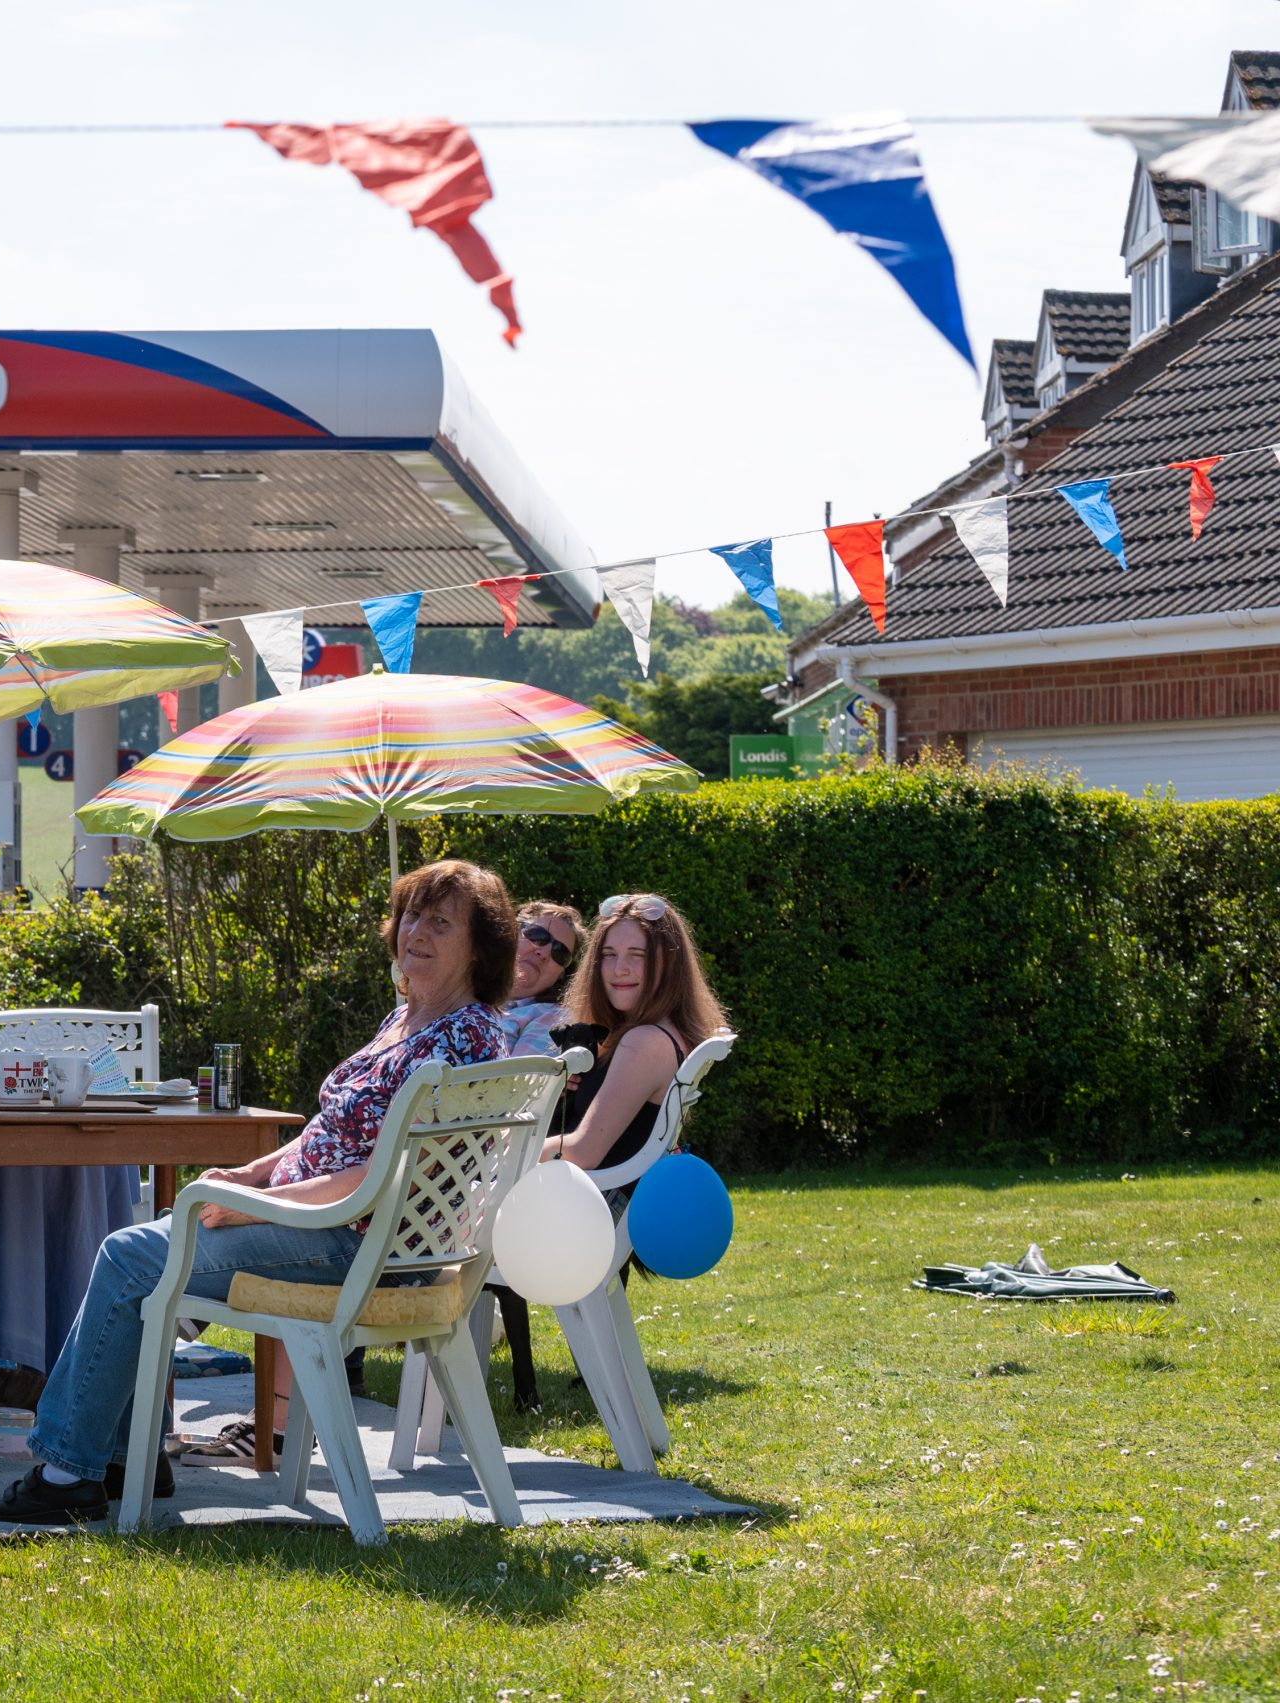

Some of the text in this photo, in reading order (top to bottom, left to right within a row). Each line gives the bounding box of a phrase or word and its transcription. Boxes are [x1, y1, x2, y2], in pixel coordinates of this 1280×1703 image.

[30, 728, 38, 752] 1
[51, 755, 66, 777] 4
[739, 748, 788, 763] Londis
